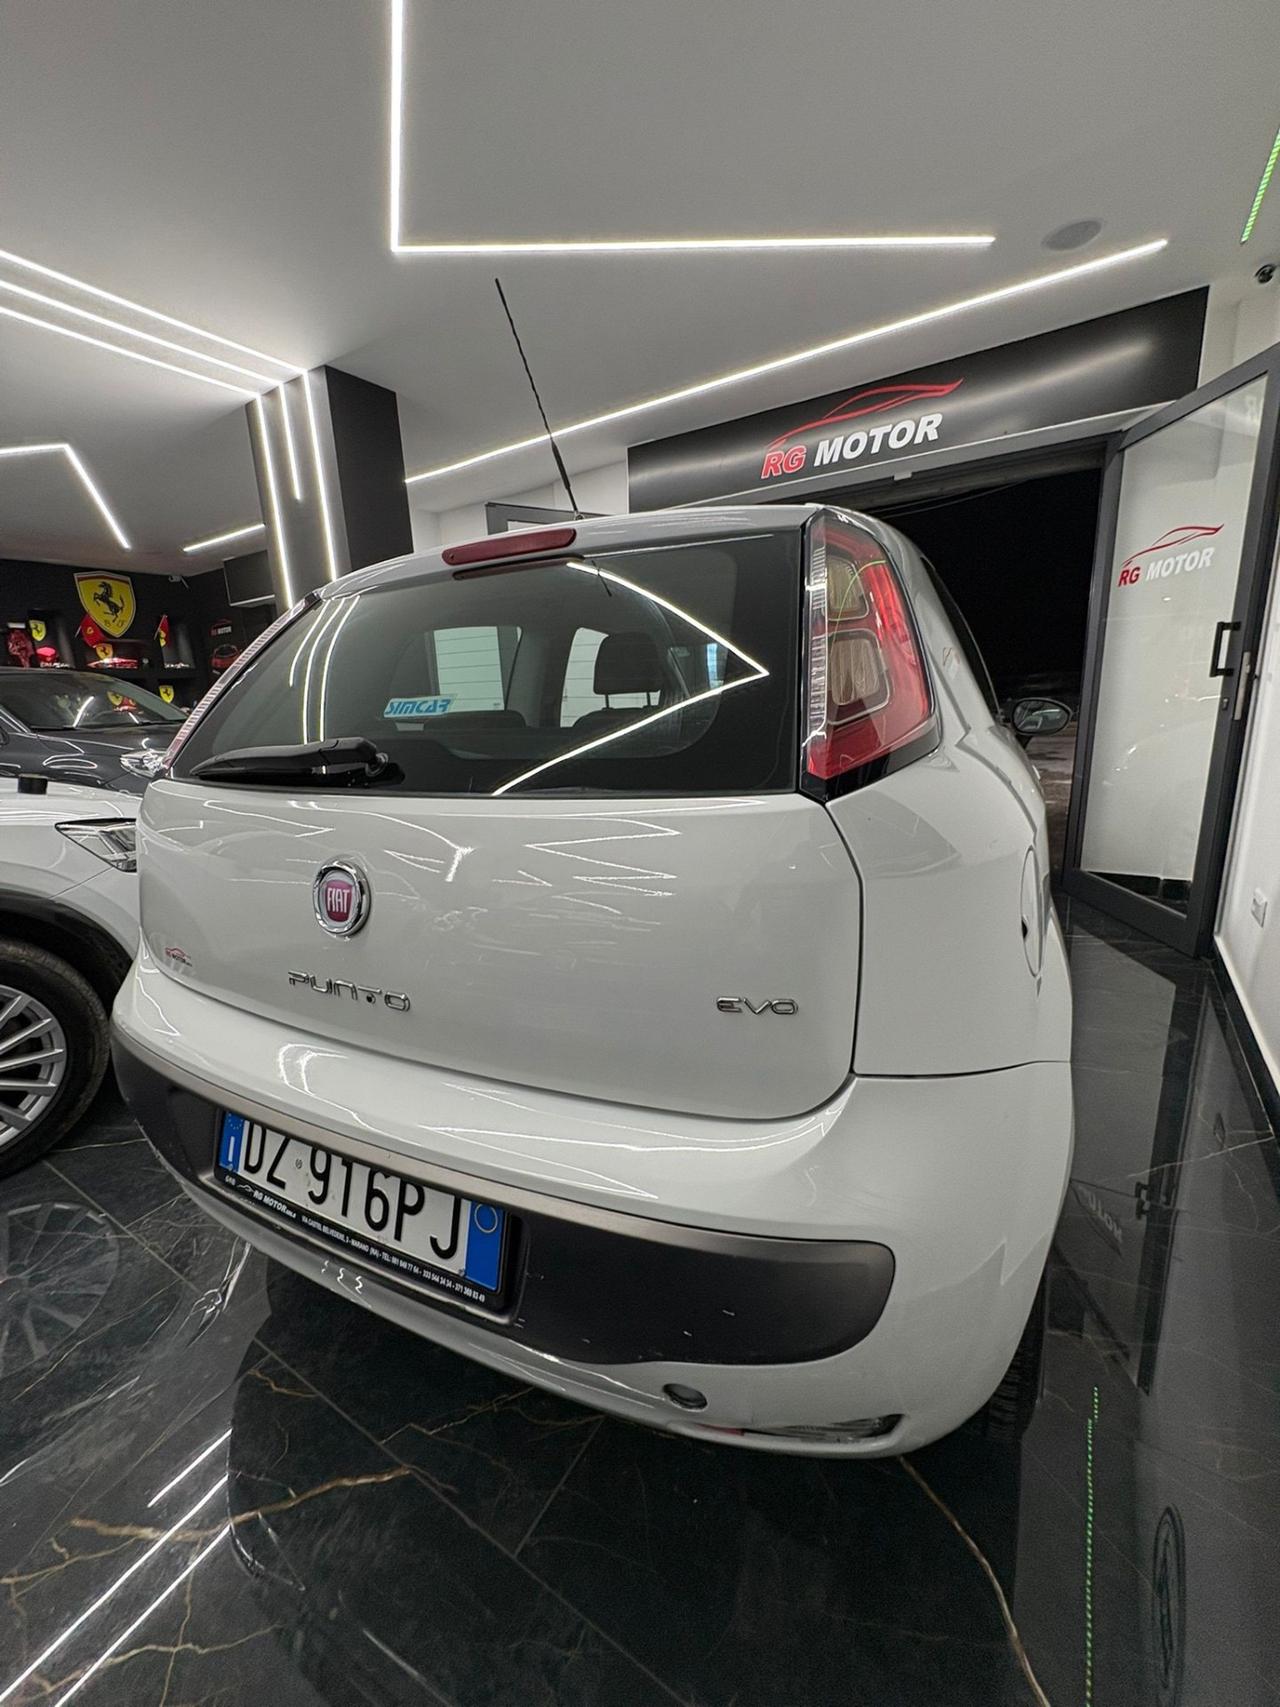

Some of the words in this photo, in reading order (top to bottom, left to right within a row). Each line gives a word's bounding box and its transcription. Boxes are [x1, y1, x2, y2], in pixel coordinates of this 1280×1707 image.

[761, 445, 807, 479] RG
[813, 412, 943, 467] MOTOR
[1118, 566, 1141, 587] RG
[1145, 547, 1215, 582] MOTOR
[326, 887, 351, 914] FIAT
[287, 970, 411, 1012] PUNTO
[716, 996, 799, 1016] EVO
[243, 1120, 291, 1190] DZ
[308, 1148, 462, 1260] 916PJ
[263, 1195, 287, 1212] MOTOR
